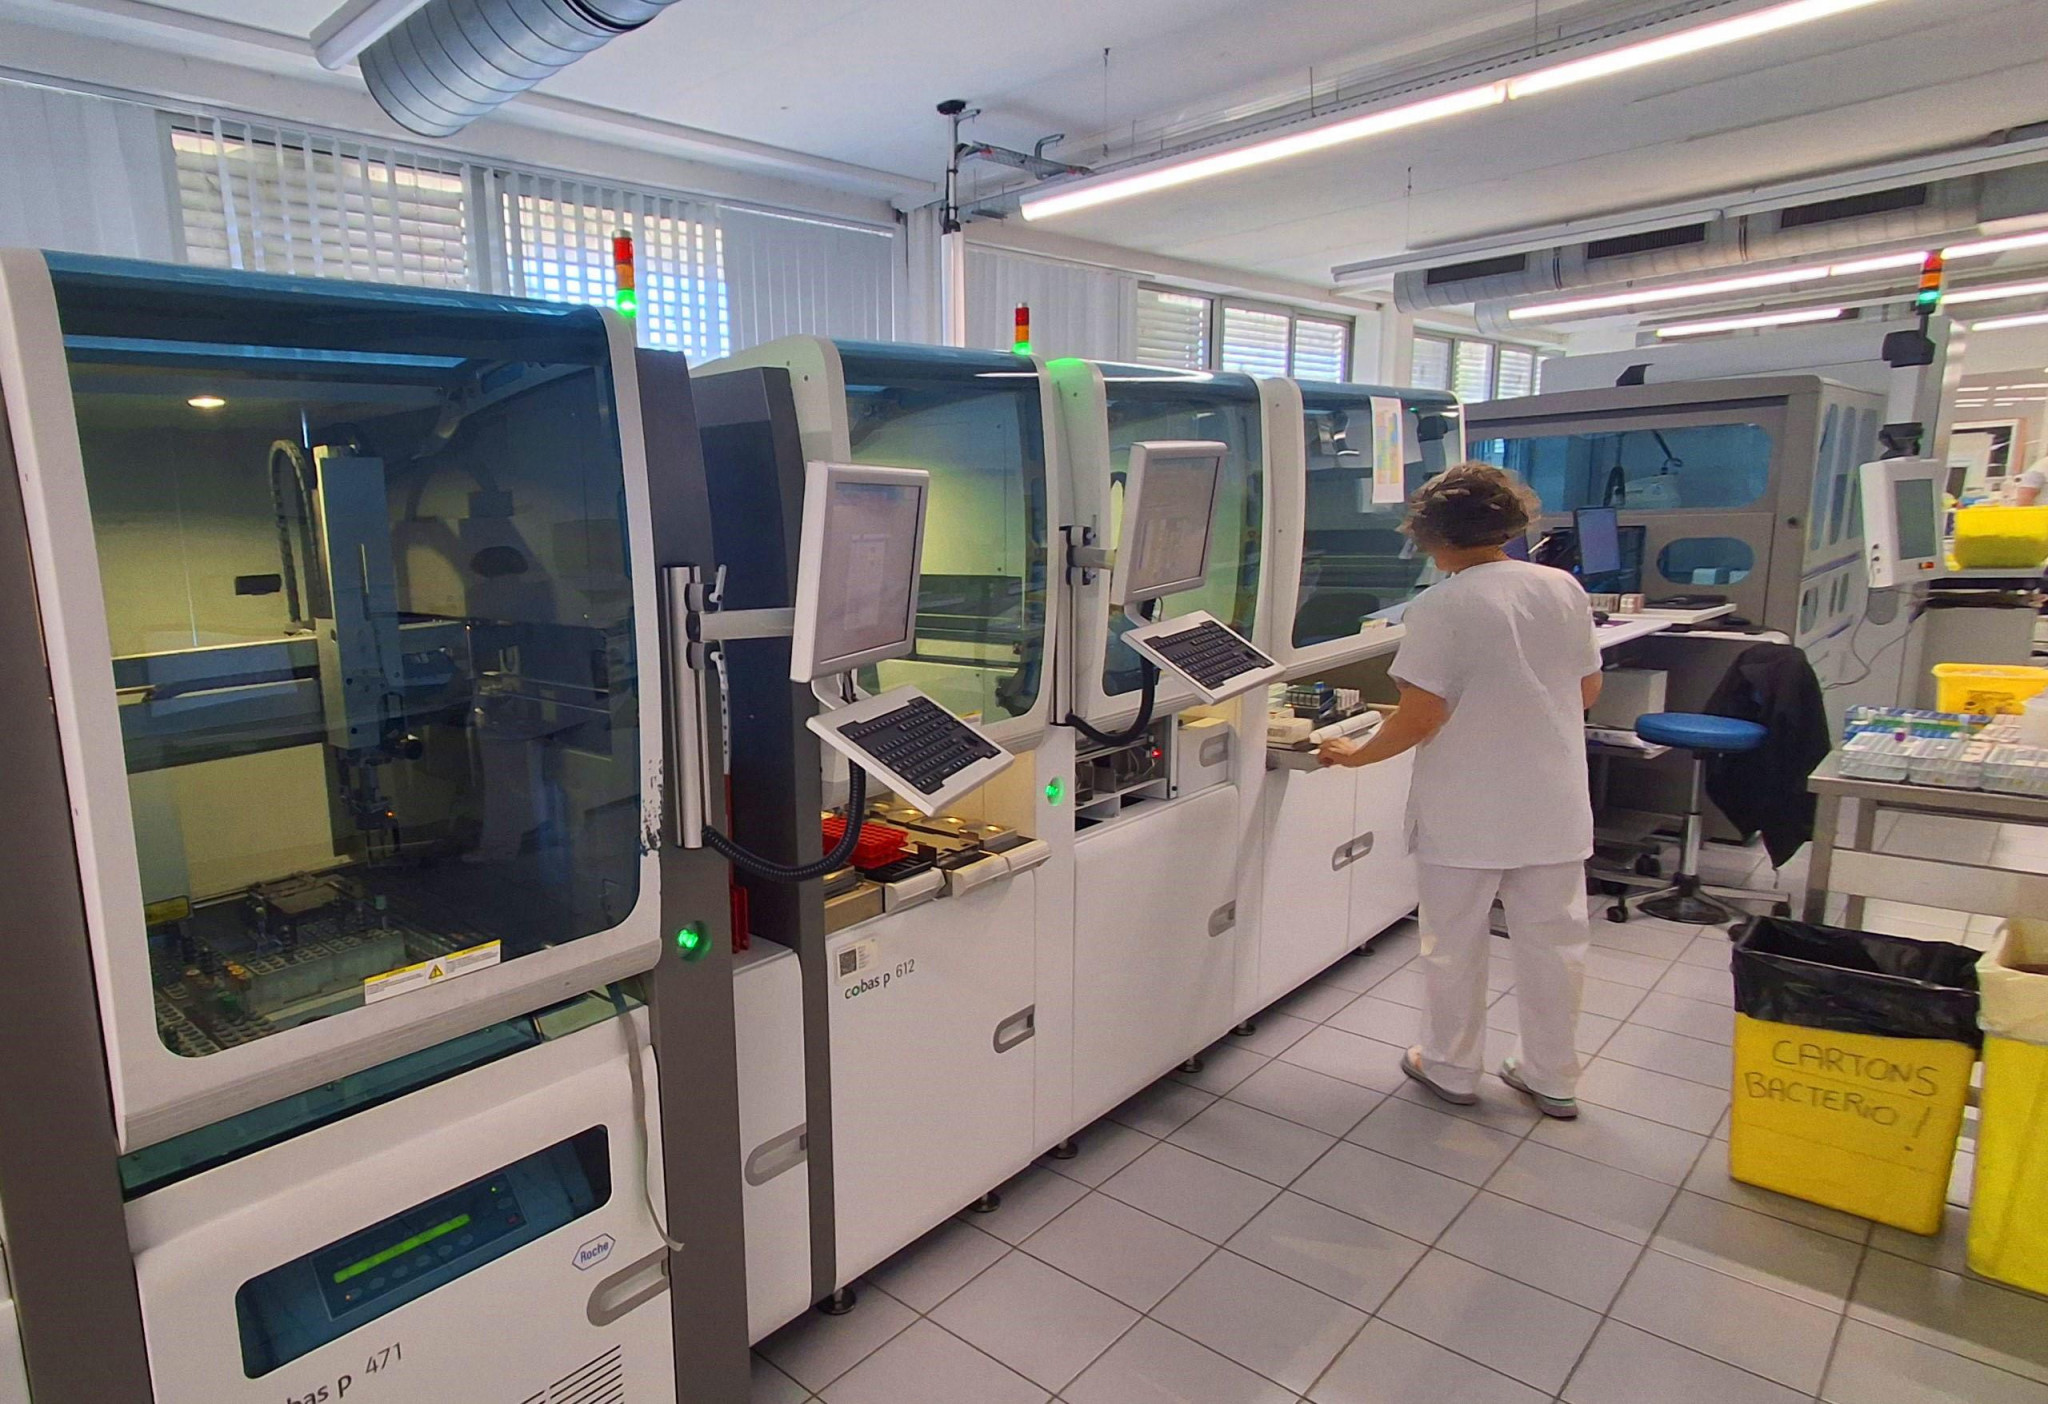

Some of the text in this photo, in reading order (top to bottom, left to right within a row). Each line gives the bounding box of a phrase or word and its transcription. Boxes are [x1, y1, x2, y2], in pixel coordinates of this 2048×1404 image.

[844, 958, 915, 1000] cobas p 612
[1772, 1040, 1940, 1097] CARTONS
[580, 1241, 609, 1264] Roche
[336, 1374, 353, 1399] p
[364, 1341, 402, 1375] 471
